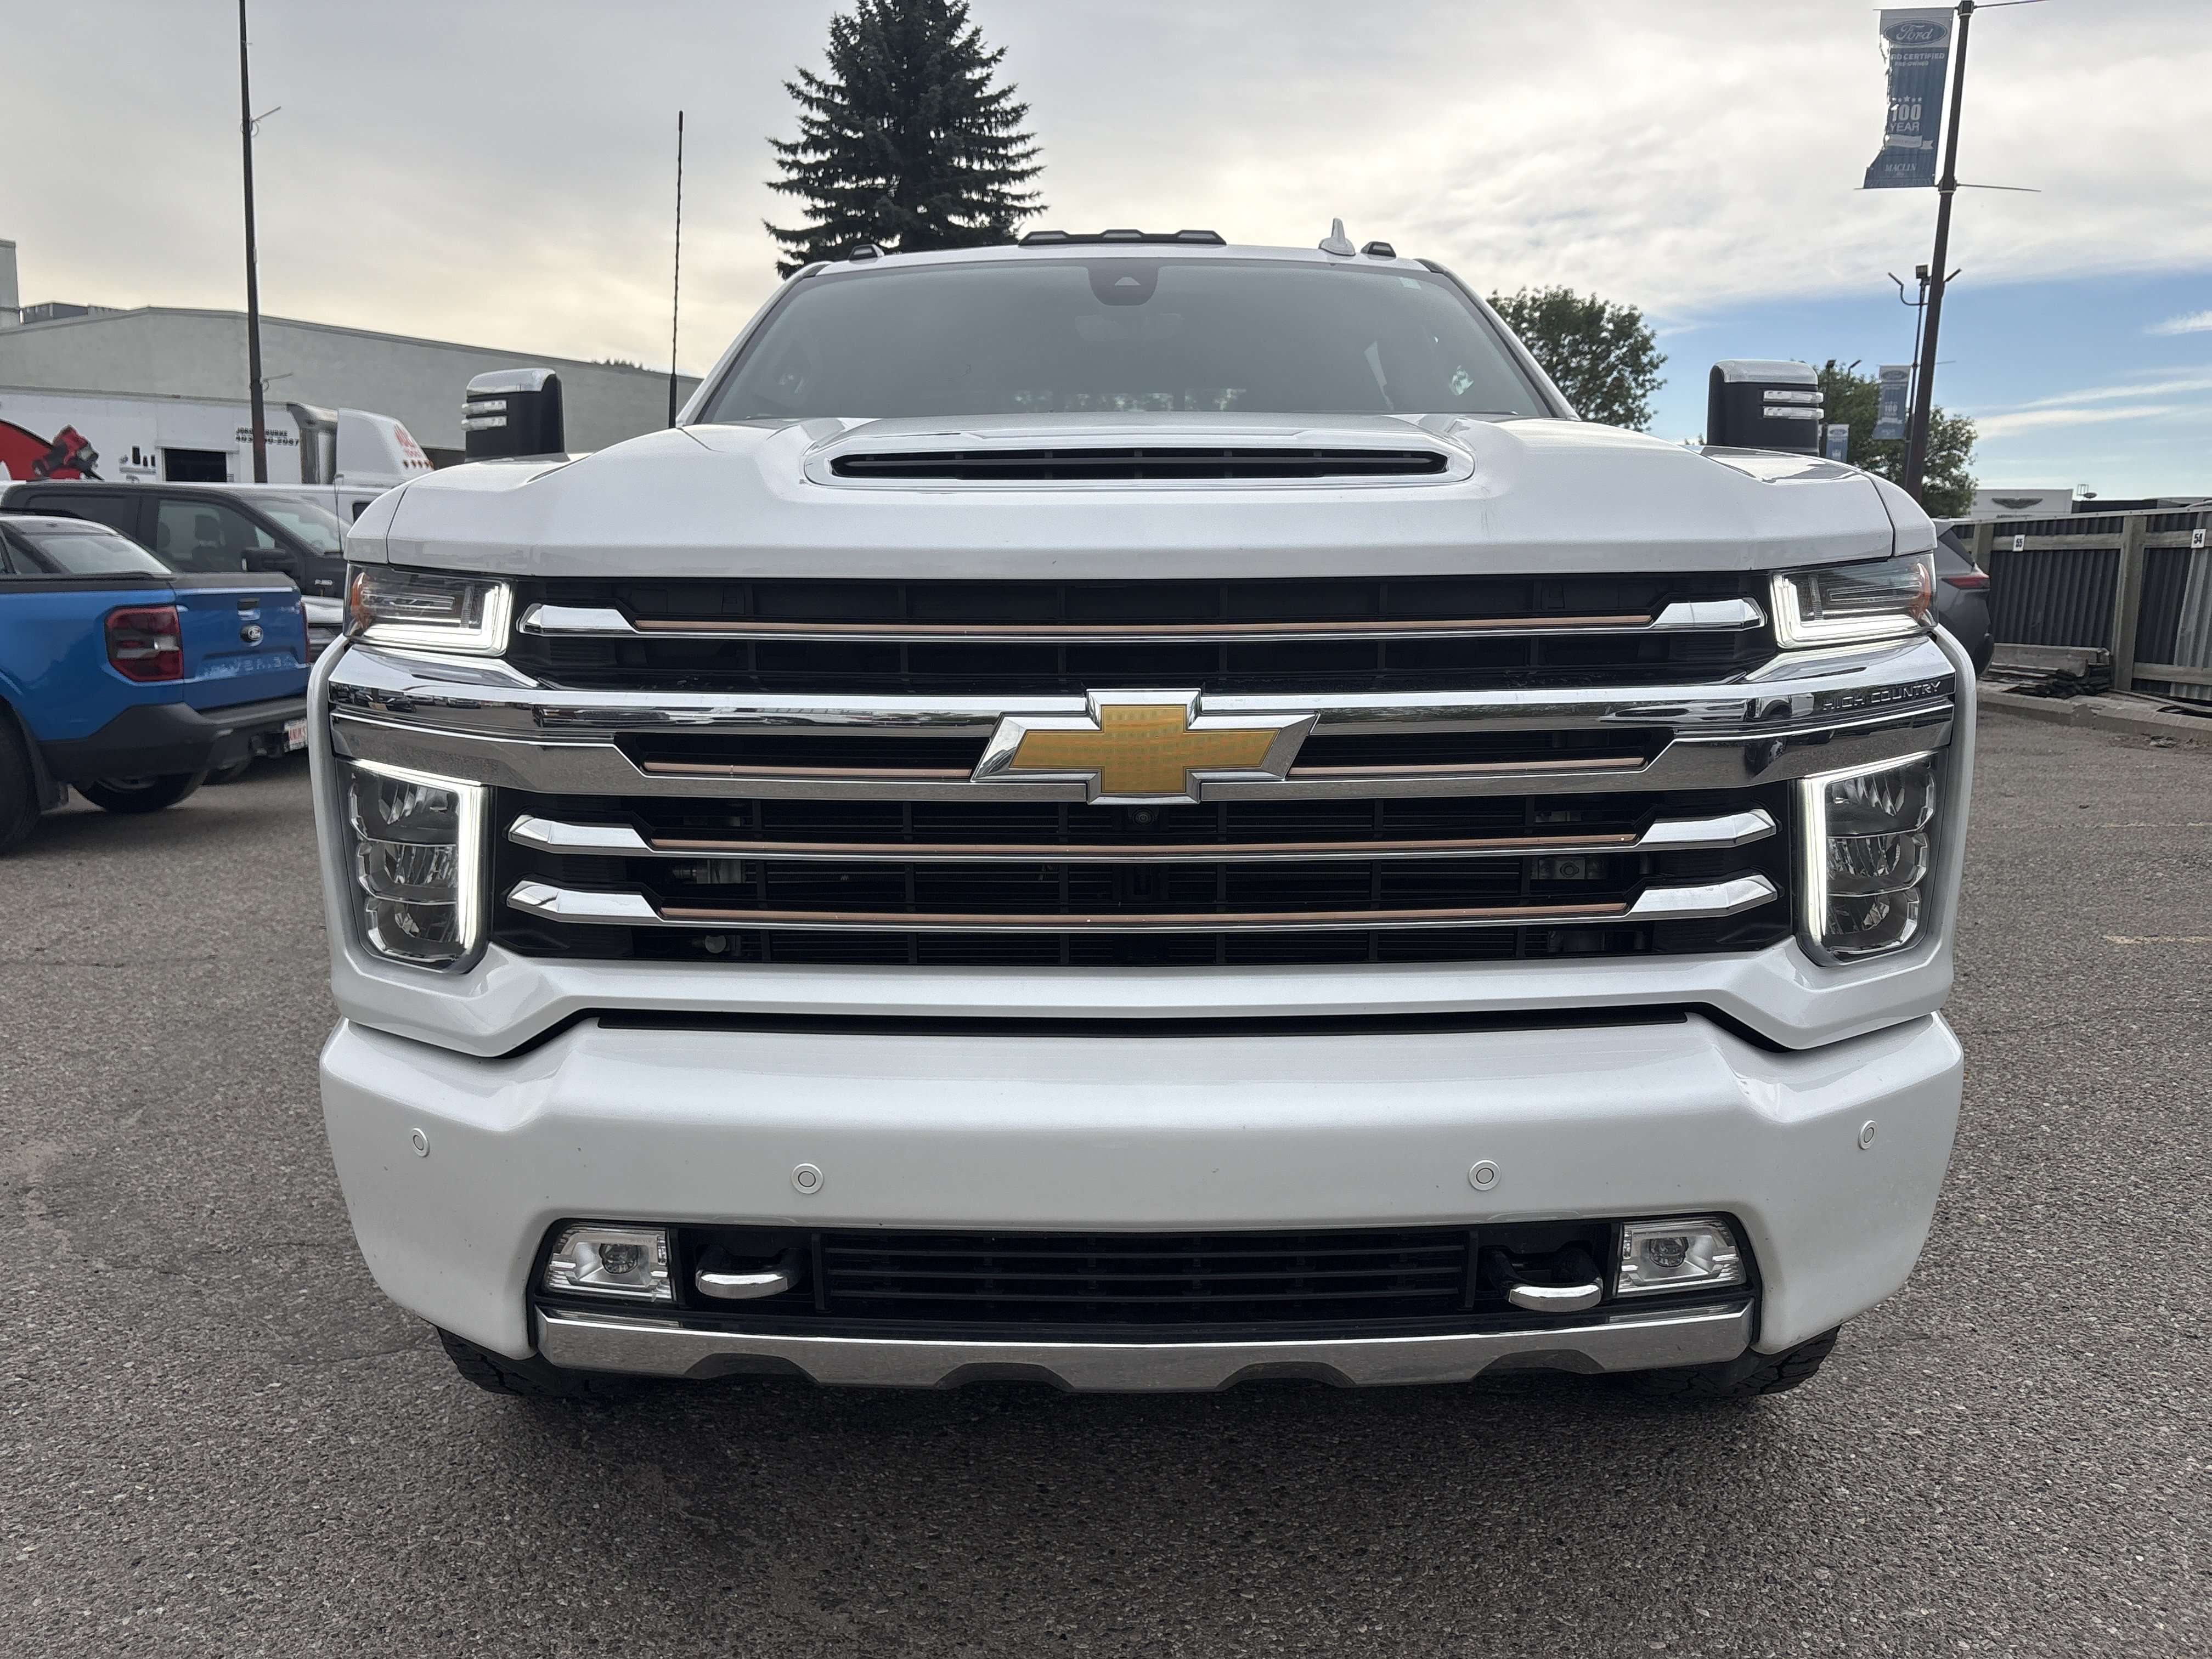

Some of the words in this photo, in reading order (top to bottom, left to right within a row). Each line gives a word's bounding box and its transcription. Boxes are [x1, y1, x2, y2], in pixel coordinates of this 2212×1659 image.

[1896, 22, 1934, 40] Ford
[1891, 104, 1922, 121] 100
[1890, 121, 1920, 132] YEAR
[1884, 163, 1917, 172] MACLIN
[2016, 538, 2023, 548] 55
[2194, 533, 2203, 544] 54
[1871, 681, 1941, 703] COUNTRY
